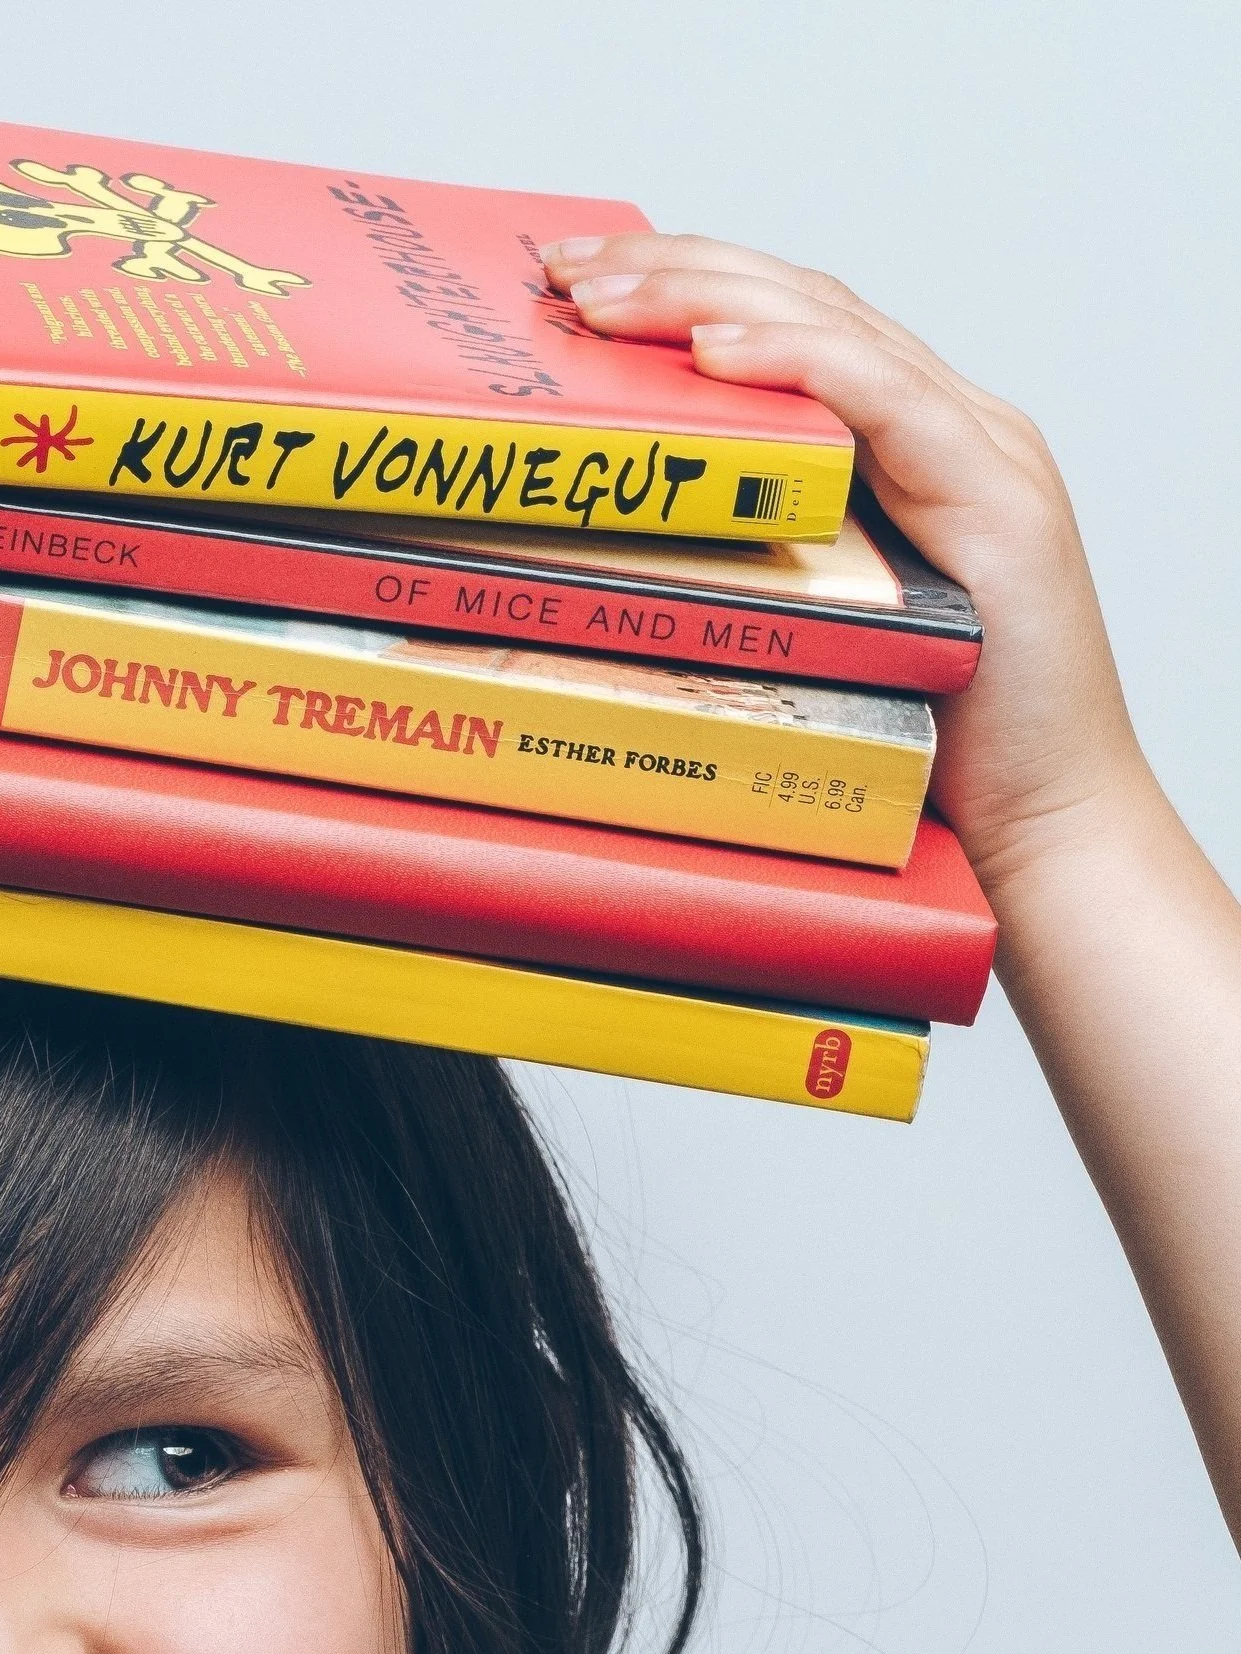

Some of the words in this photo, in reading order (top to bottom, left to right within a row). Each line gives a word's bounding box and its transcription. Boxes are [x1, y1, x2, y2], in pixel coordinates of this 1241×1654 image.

[109, 416, 316, 490] KURT
[332, 424, 708, 528] VONNEGUT
[786, 479, 804, 522] Dell
[374, 575, 431, 606] OF
[455, 585, 561, 626] MICE
[586, 604, 677, 641] AND
[702, 620, 796, 659] MEN
[31, 649, 258, 718] JOHNNY
[266, 684, 505, 760] TREMAIN
[517, 733, 617, 767] ESTHER
[623, 750, 719, 783] FORBES
[751, 771, 773, 795] FIC
[777, 771, 800, 803] 4.99
[797, 778, 822, 805] U.S.
[824, 779, 847, 810] 6.99
[844, 784, 869, 813] Can.
[815, 1036, 844, 1093] nyrb
